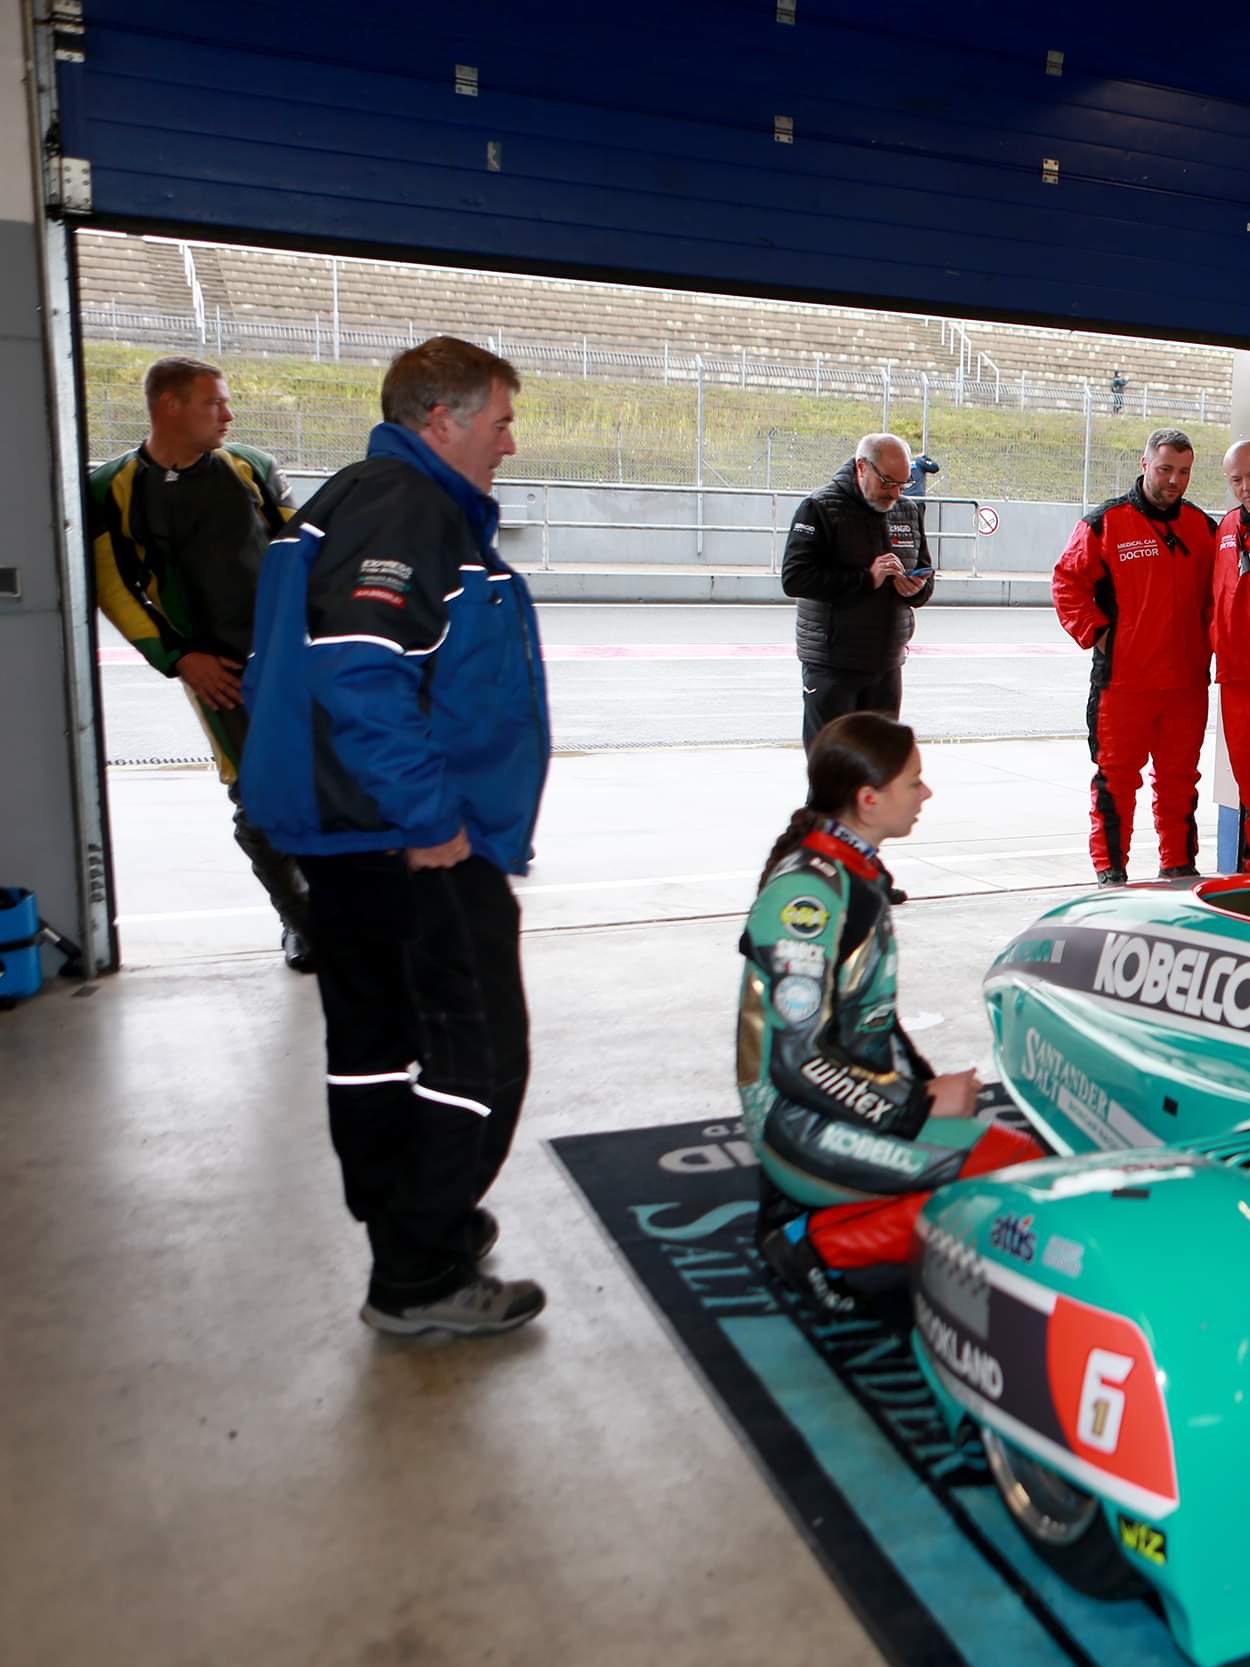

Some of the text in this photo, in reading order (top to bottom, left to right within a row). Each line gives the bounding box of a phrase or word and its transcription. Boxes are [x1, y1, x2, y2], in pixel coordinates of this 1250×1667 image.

[1117, 541, 1142, 549] MEDICAL
[1120, 548, 1159, 561] DOCTOR
[802, 1057, 893, 1124] wintex
[1021, 1027, 1113, 1123] SANTANDER
[991, 1211, 1036, 1264] attis
[1077, 1347, 1136, 1454] 6
[1091, 1399, 1111, 1437] 1
